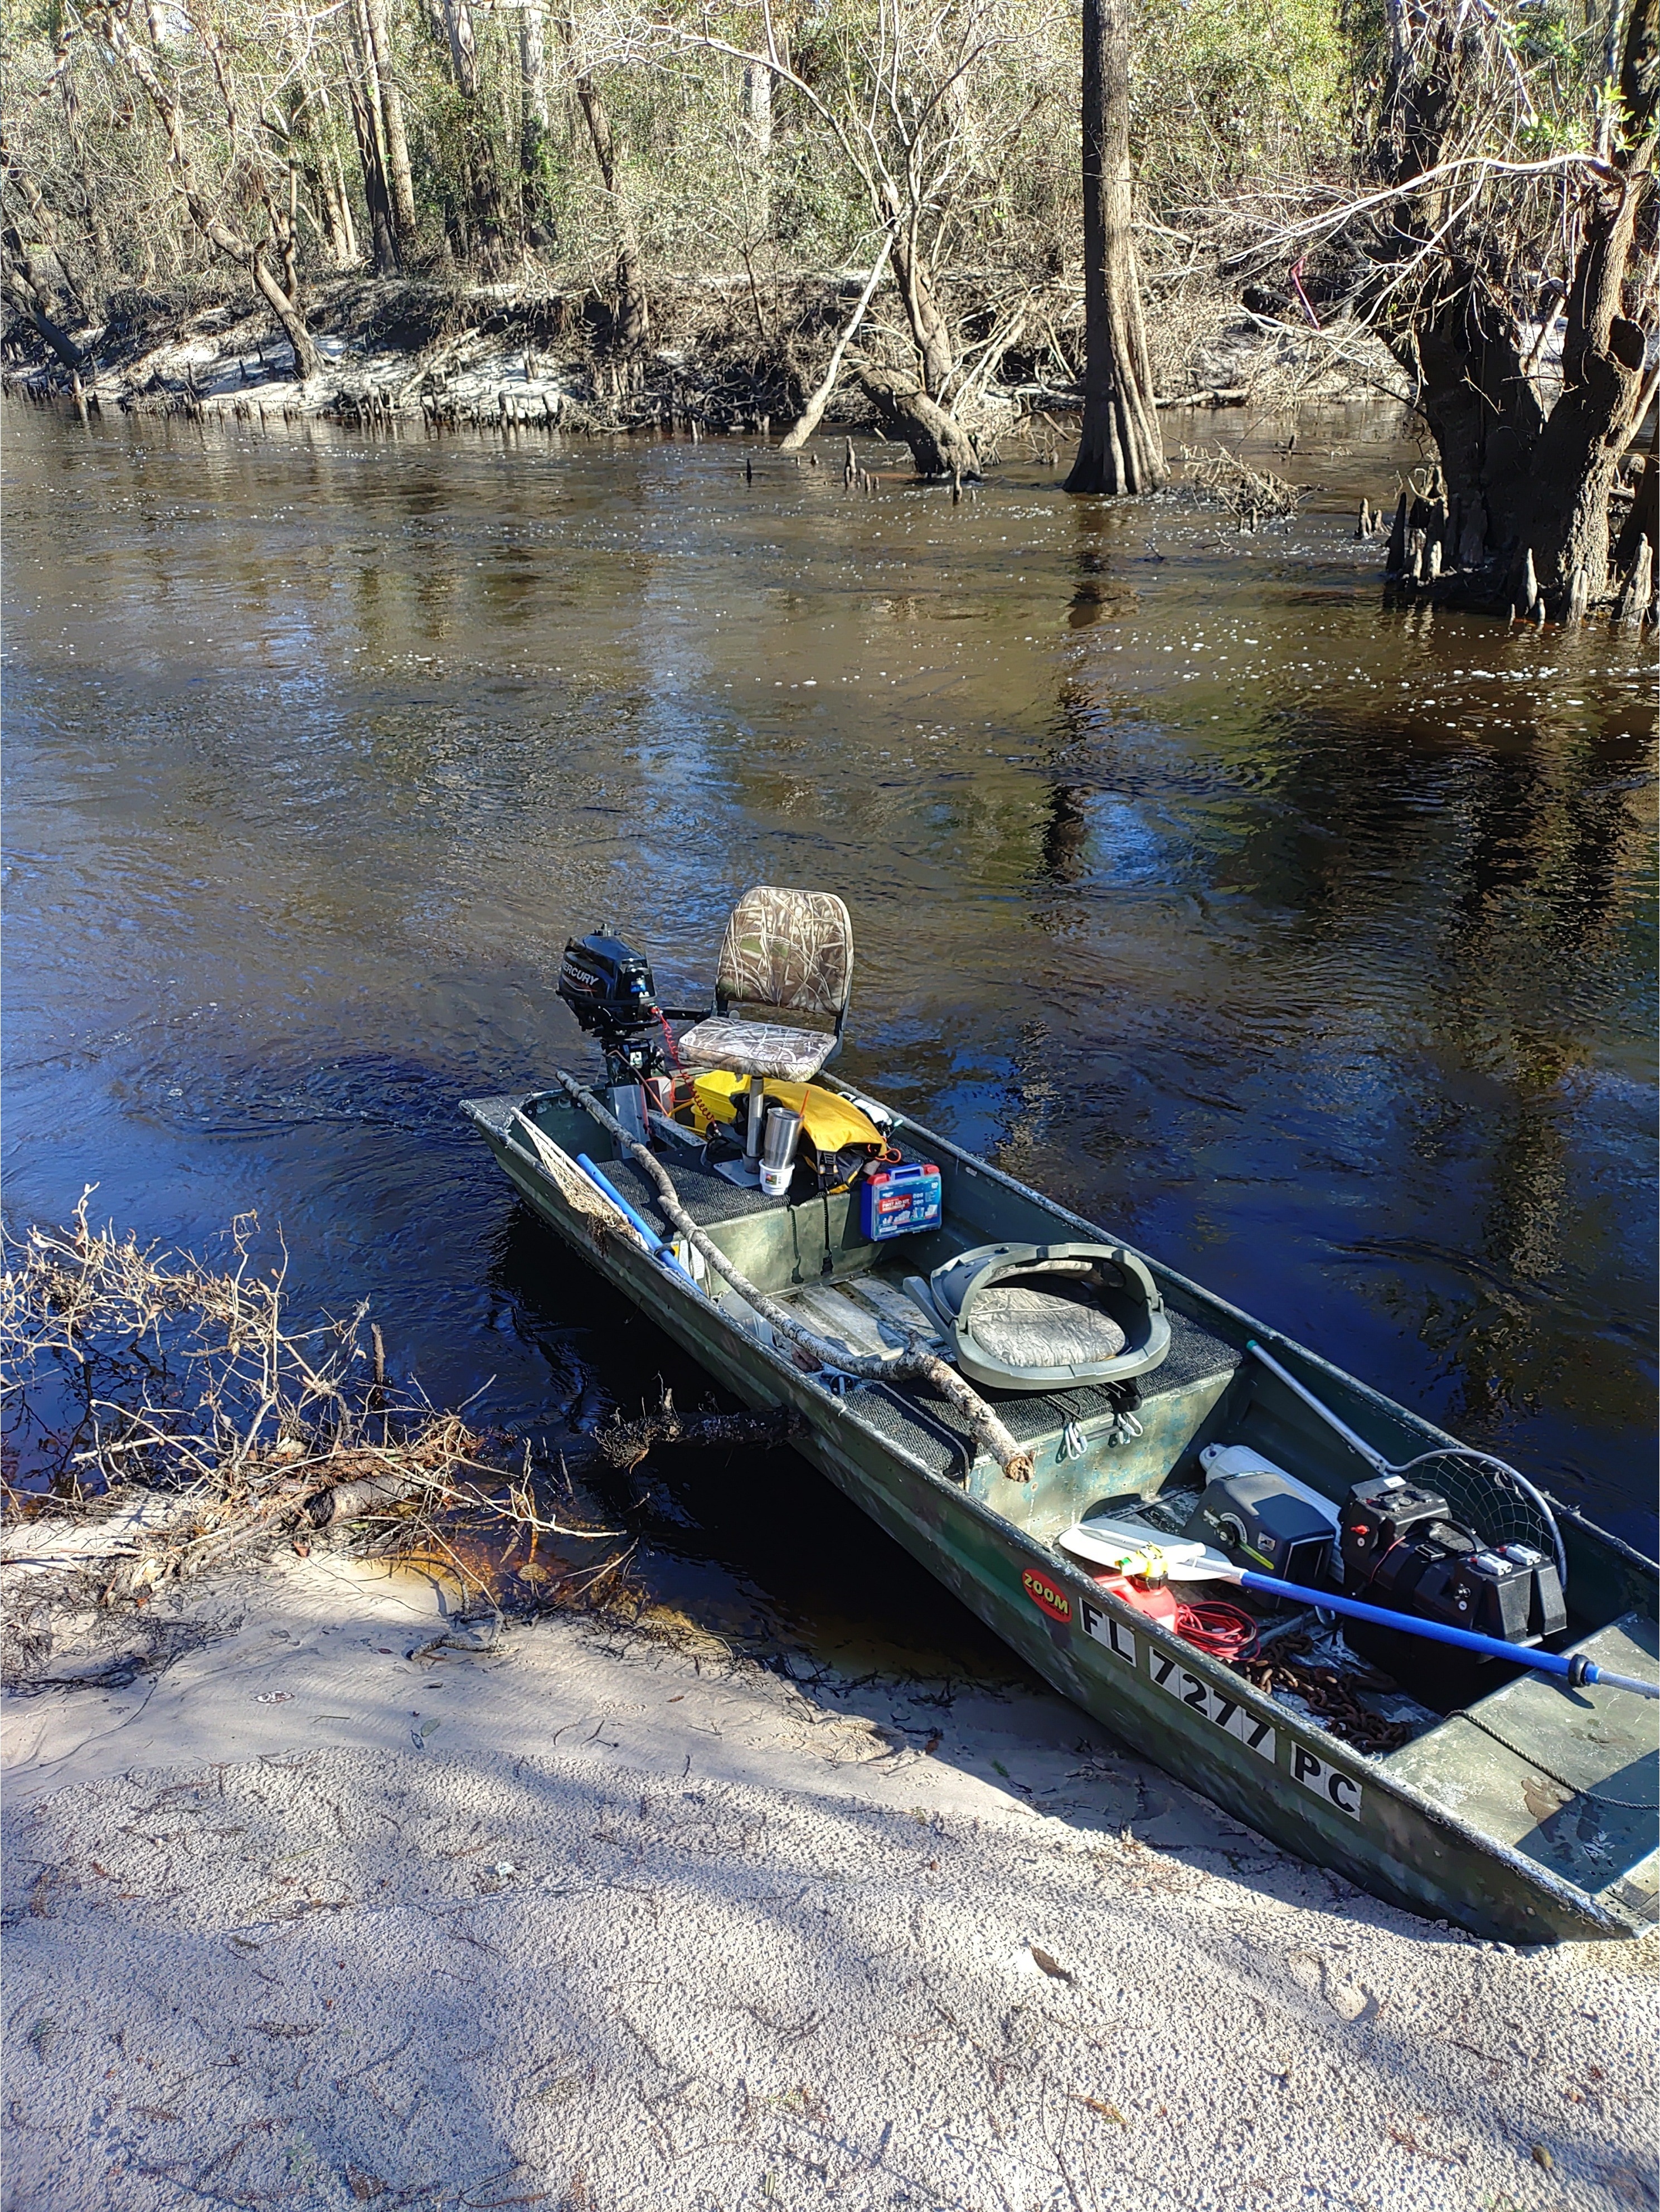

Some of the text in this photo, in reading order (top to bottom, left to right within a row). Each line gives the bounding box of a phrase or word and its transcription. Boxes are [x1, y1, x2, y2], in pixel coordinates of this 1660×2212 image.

[1025, 1573, 1069, 1614] ZOOM
[1082, 1599, 1357, 1812] FL 7277 PC
